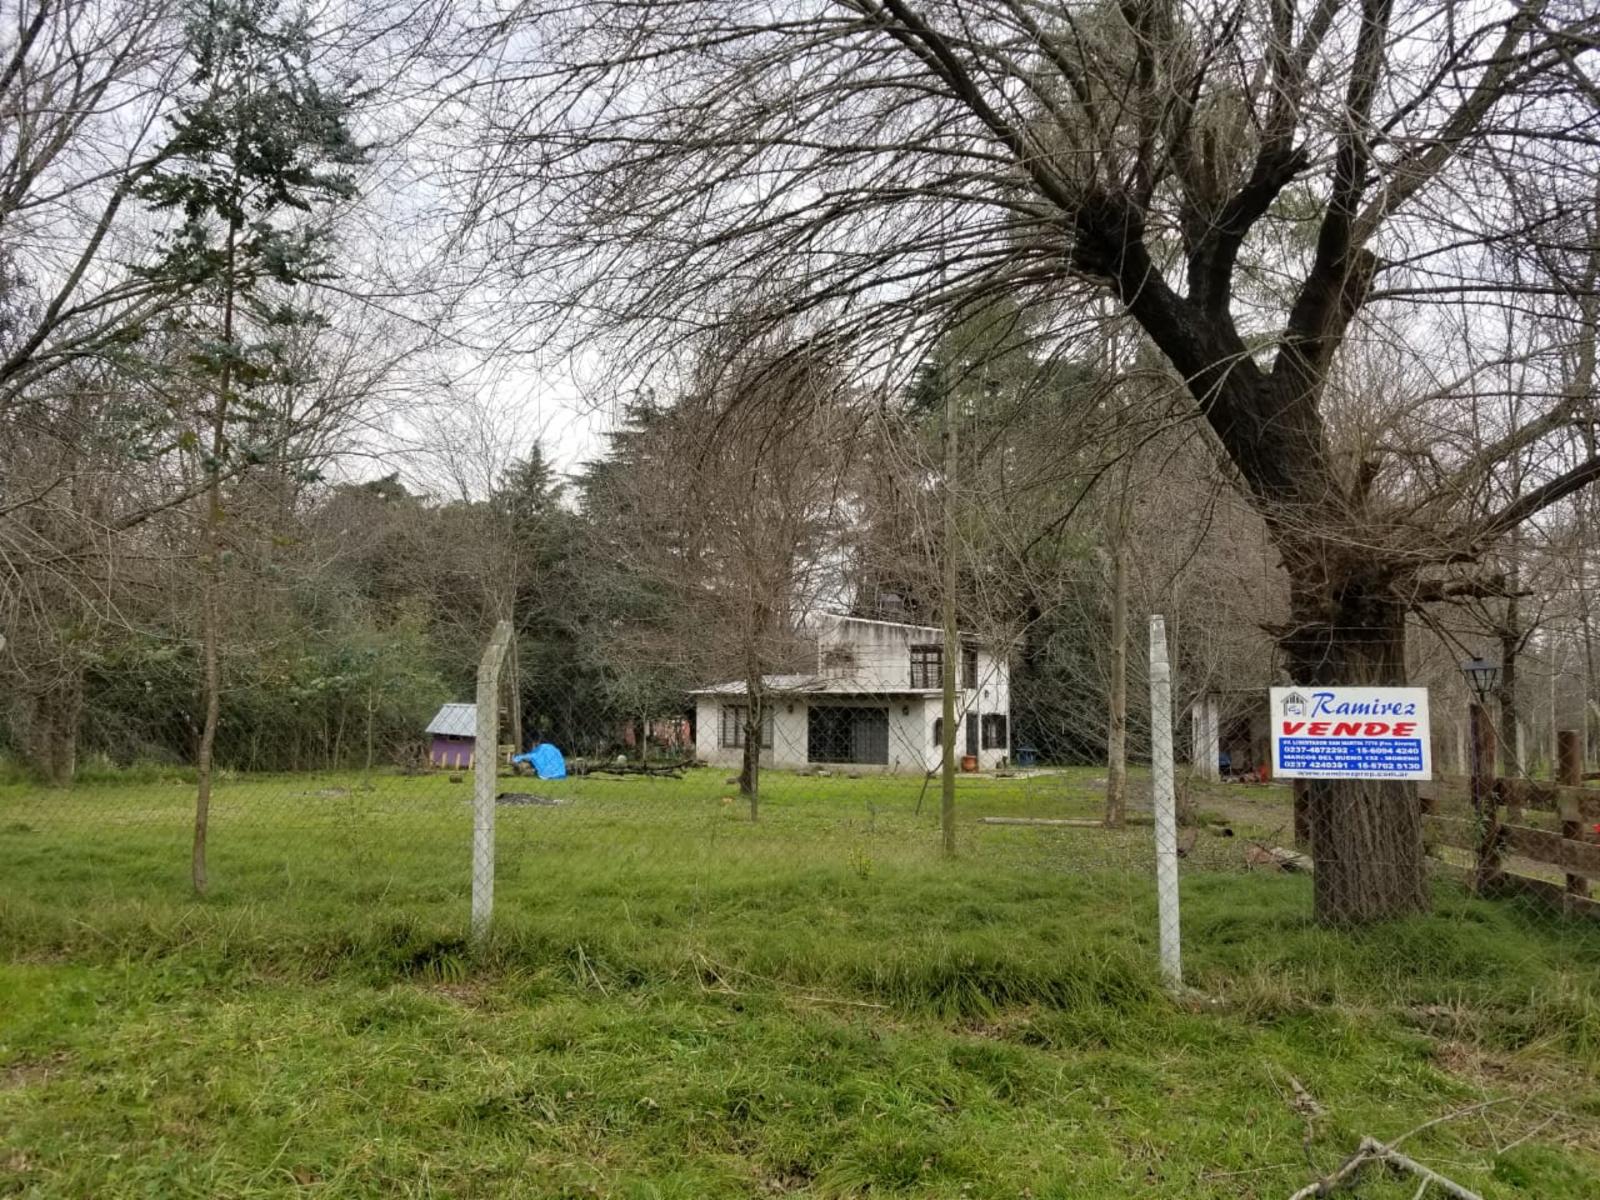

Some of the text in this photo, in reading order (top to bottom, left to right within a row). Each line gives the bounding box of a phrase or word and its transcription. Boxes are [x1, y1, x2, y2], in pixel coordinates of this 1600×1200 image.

[1311, 692, 1416, 718] Ramirez
[1283, 721, 1417, 737] VENDE
[1395, 747, 1420, 755] 4240
